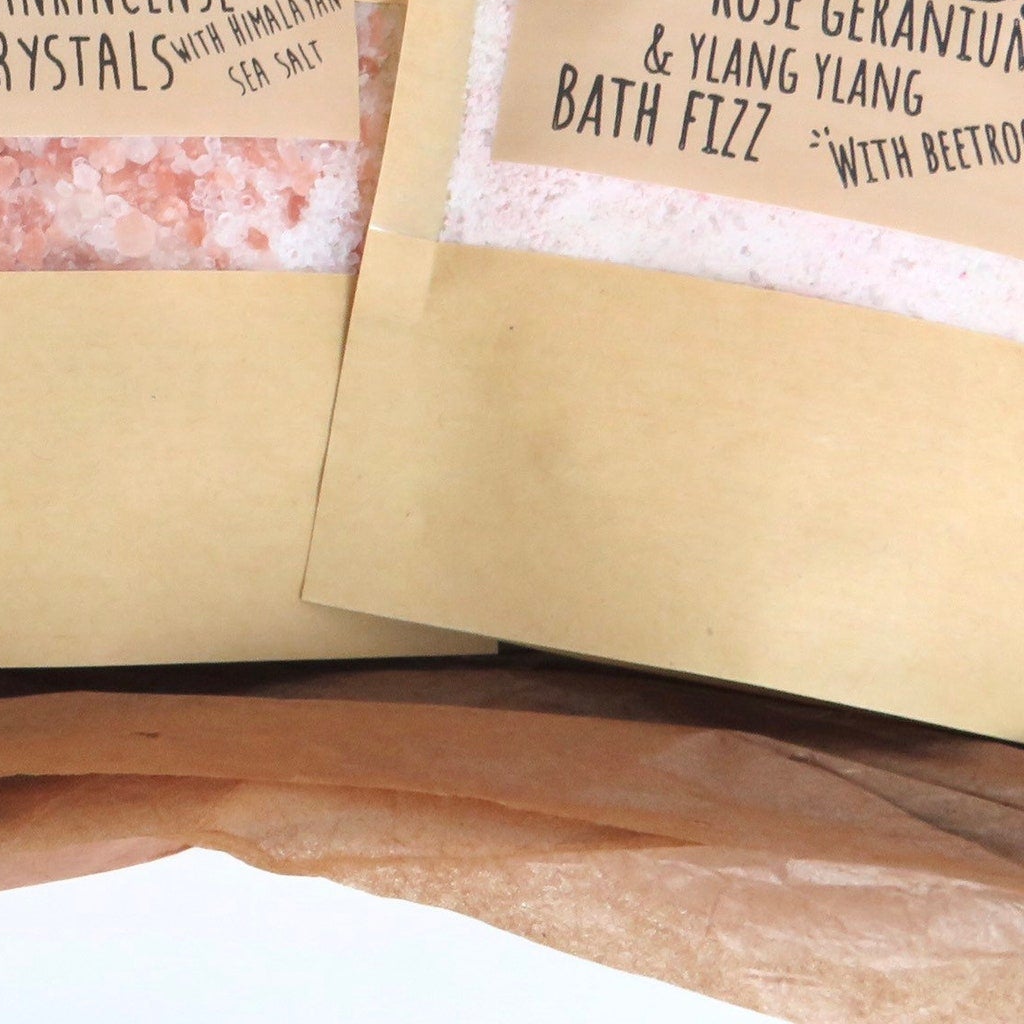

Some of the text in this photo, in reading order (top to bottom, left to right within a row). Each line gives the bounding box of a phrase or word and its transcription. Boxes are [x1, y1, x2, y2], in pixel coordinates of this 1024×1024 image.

[169, 21, 226, 64] WITH
[227, 38, 325, 97] SEA SALT
[642, 22, 925, 118] & YLANG YLANG
[550, 61, 773, 164] BATH FIZZ
[827, 117, 1024, 190] WITH BEETRO
